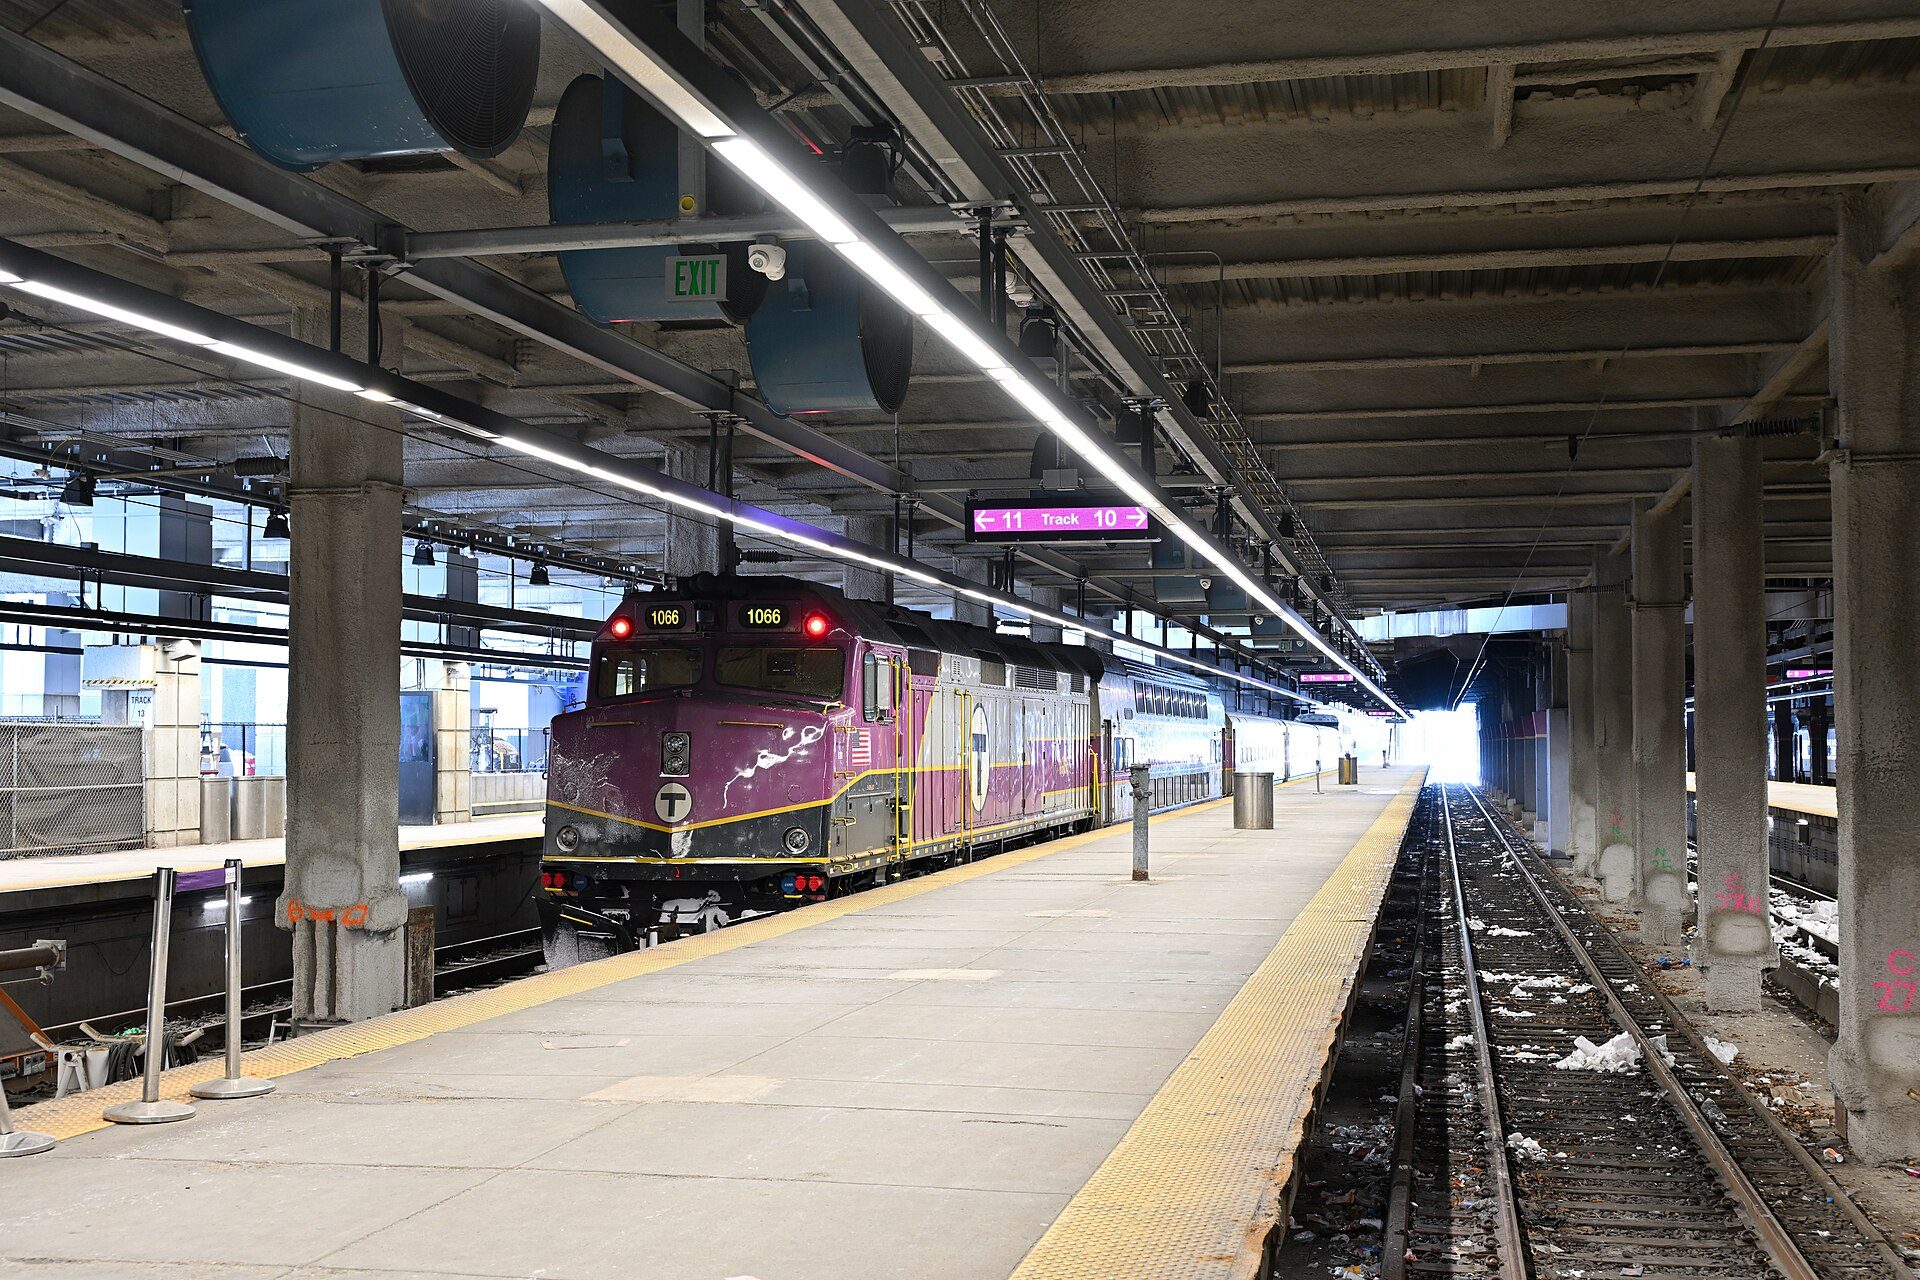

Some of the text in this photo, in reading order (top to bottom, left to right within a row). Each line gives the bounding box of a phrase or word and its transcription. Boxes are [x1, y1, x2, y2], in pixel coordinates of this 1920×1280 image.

[675, 260, 720, 295] EXIT
[1002, 509, 1117, 528] 11 Track 10
[651, 610, 679, 625] 1066
[747, 608, 781, 624] 1066
[131, 696, 152, 704] TRACK
[138, 709, 145, 717] 13
[972, 733, 986, 796] T
[661, 793, 686, 817] T
[1887, 949, 1915, 975] C
[1873, 980, 1916, 1012] 27
